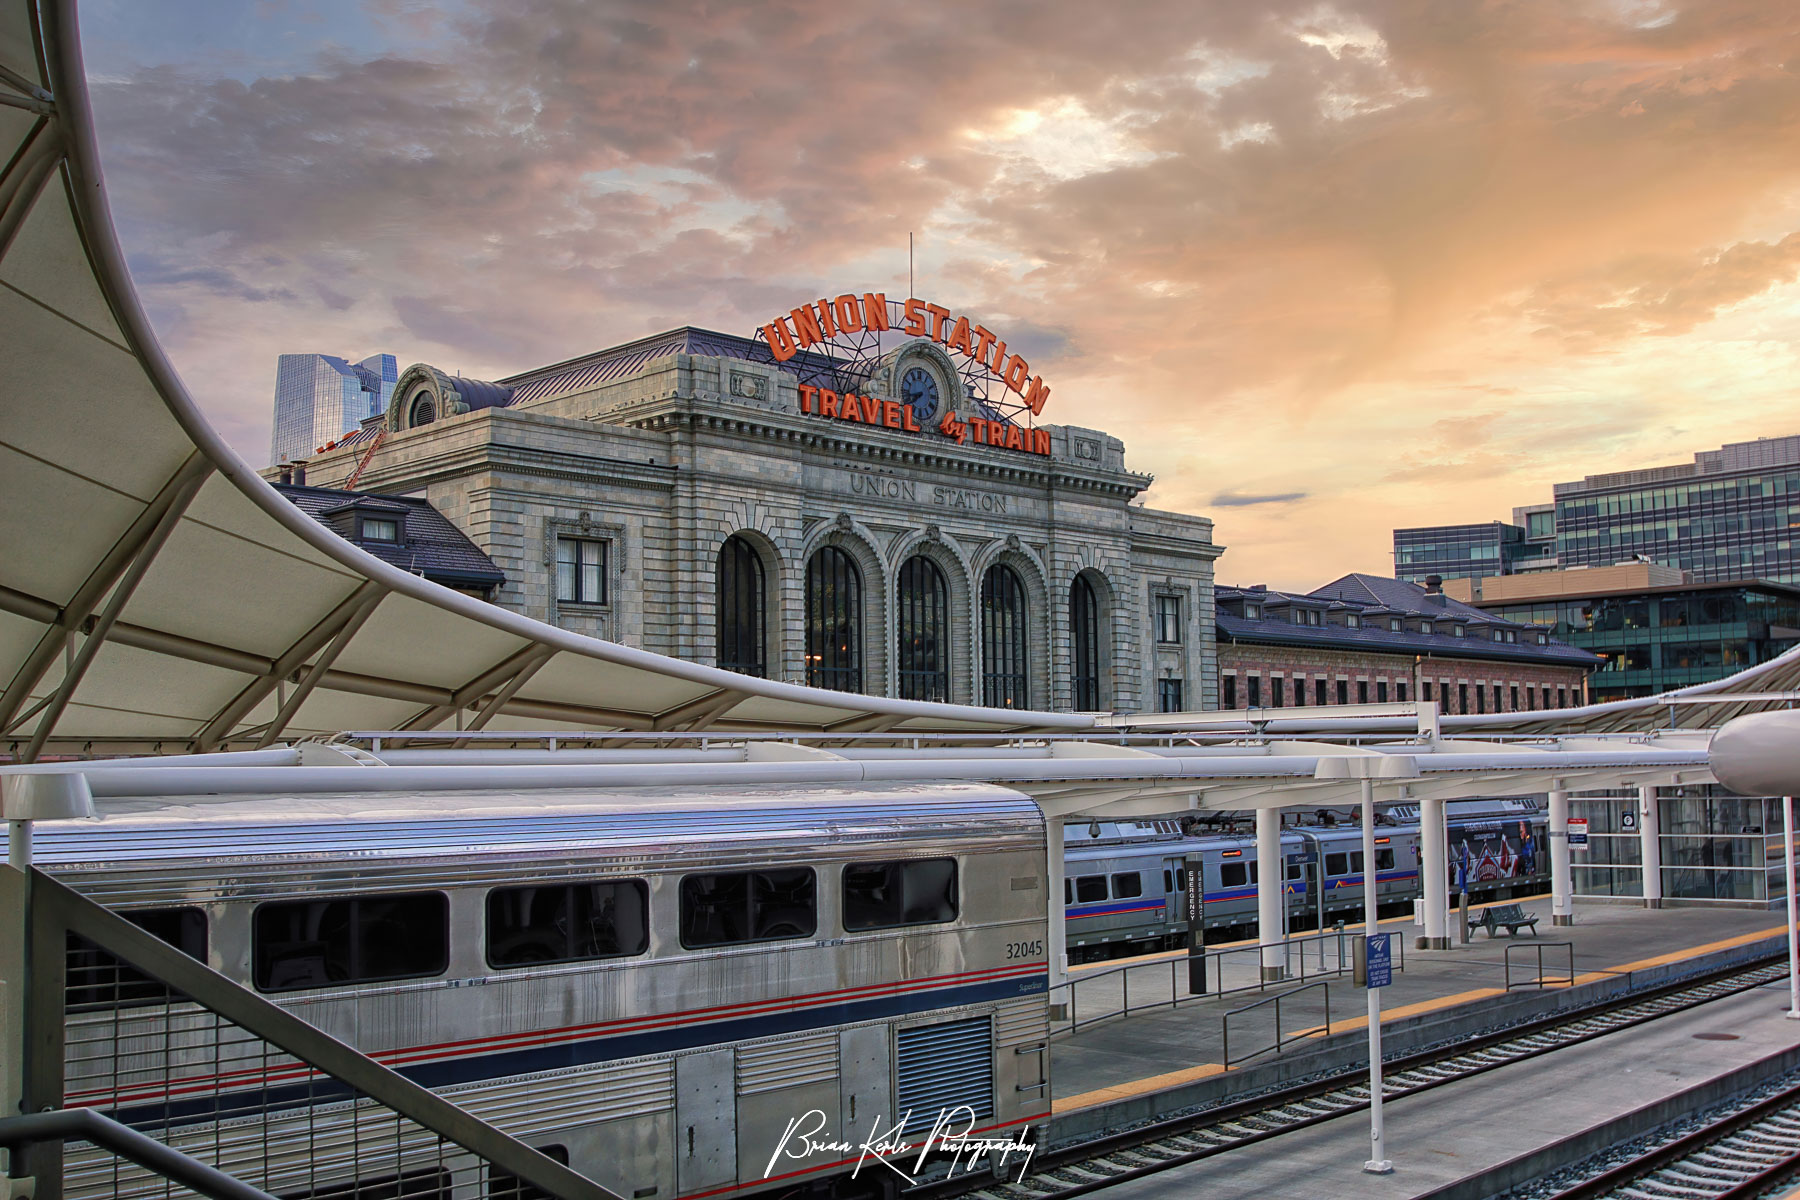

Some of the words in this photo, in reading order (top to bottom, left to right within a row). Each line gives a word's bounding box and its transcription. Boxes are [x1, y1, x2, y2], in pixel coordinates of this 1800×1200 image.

[763, 292, 890, 362] UNION
[904, 298, 1051, 416] STATION
[799, 384, 920, 432] TRAVEL
[939, 411, 968, 445] by
[969, 417, 1051, 455] TRAIN
[850, 474, 916, 502] UNION
[933, 486, 1007, 514] STATION
[1188, 870, 1196, 921] EMERGENCY
[1006, 940, 1043, 960] 32045
